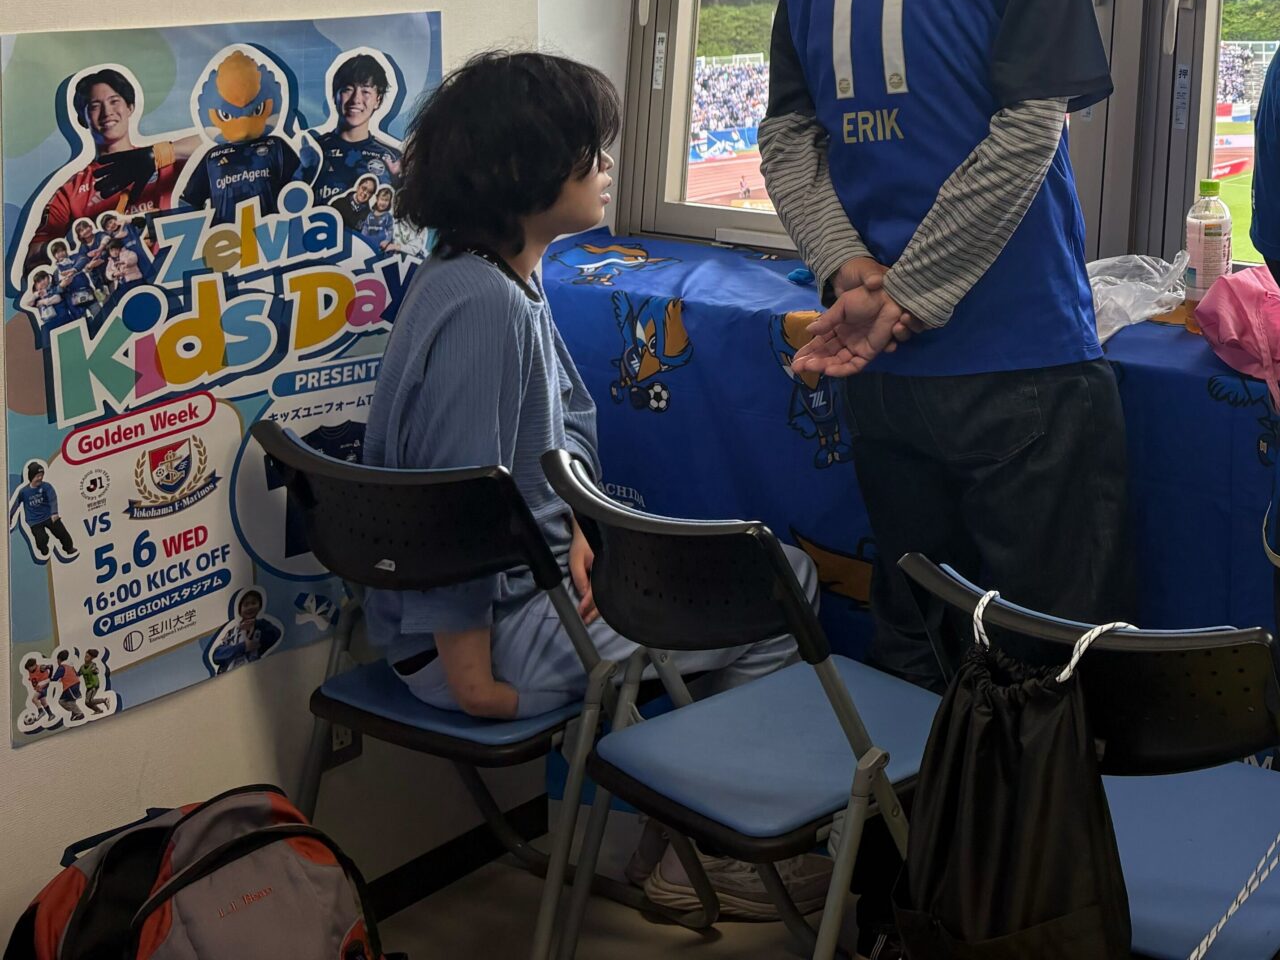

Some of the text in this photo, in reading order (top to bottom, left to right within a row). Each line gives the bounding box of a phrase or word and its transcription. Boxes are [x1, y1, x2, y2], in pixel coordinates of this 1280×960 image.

[842, 108, 904, 144] ERIK
[156, 186, 338, 284] Zelvia
[57, 261, 418, 422] Kids Day
[295, 361, 379, 391] PRESENT
[77, 402, 200, 454] Golden Week
[133, 506, 173, 518] Yokohama
[598, 480, 646, 508] ACHIDA
[83, 511, 112, 537] VS
[94, 525, 208, 584] 5.6 WED
[83, 543, 231, 616] 16:00 KICK OFF
[114, 577, 223, 626] 町田GIONスタジアム
[148, 609, 197, 638] 玉川大学
